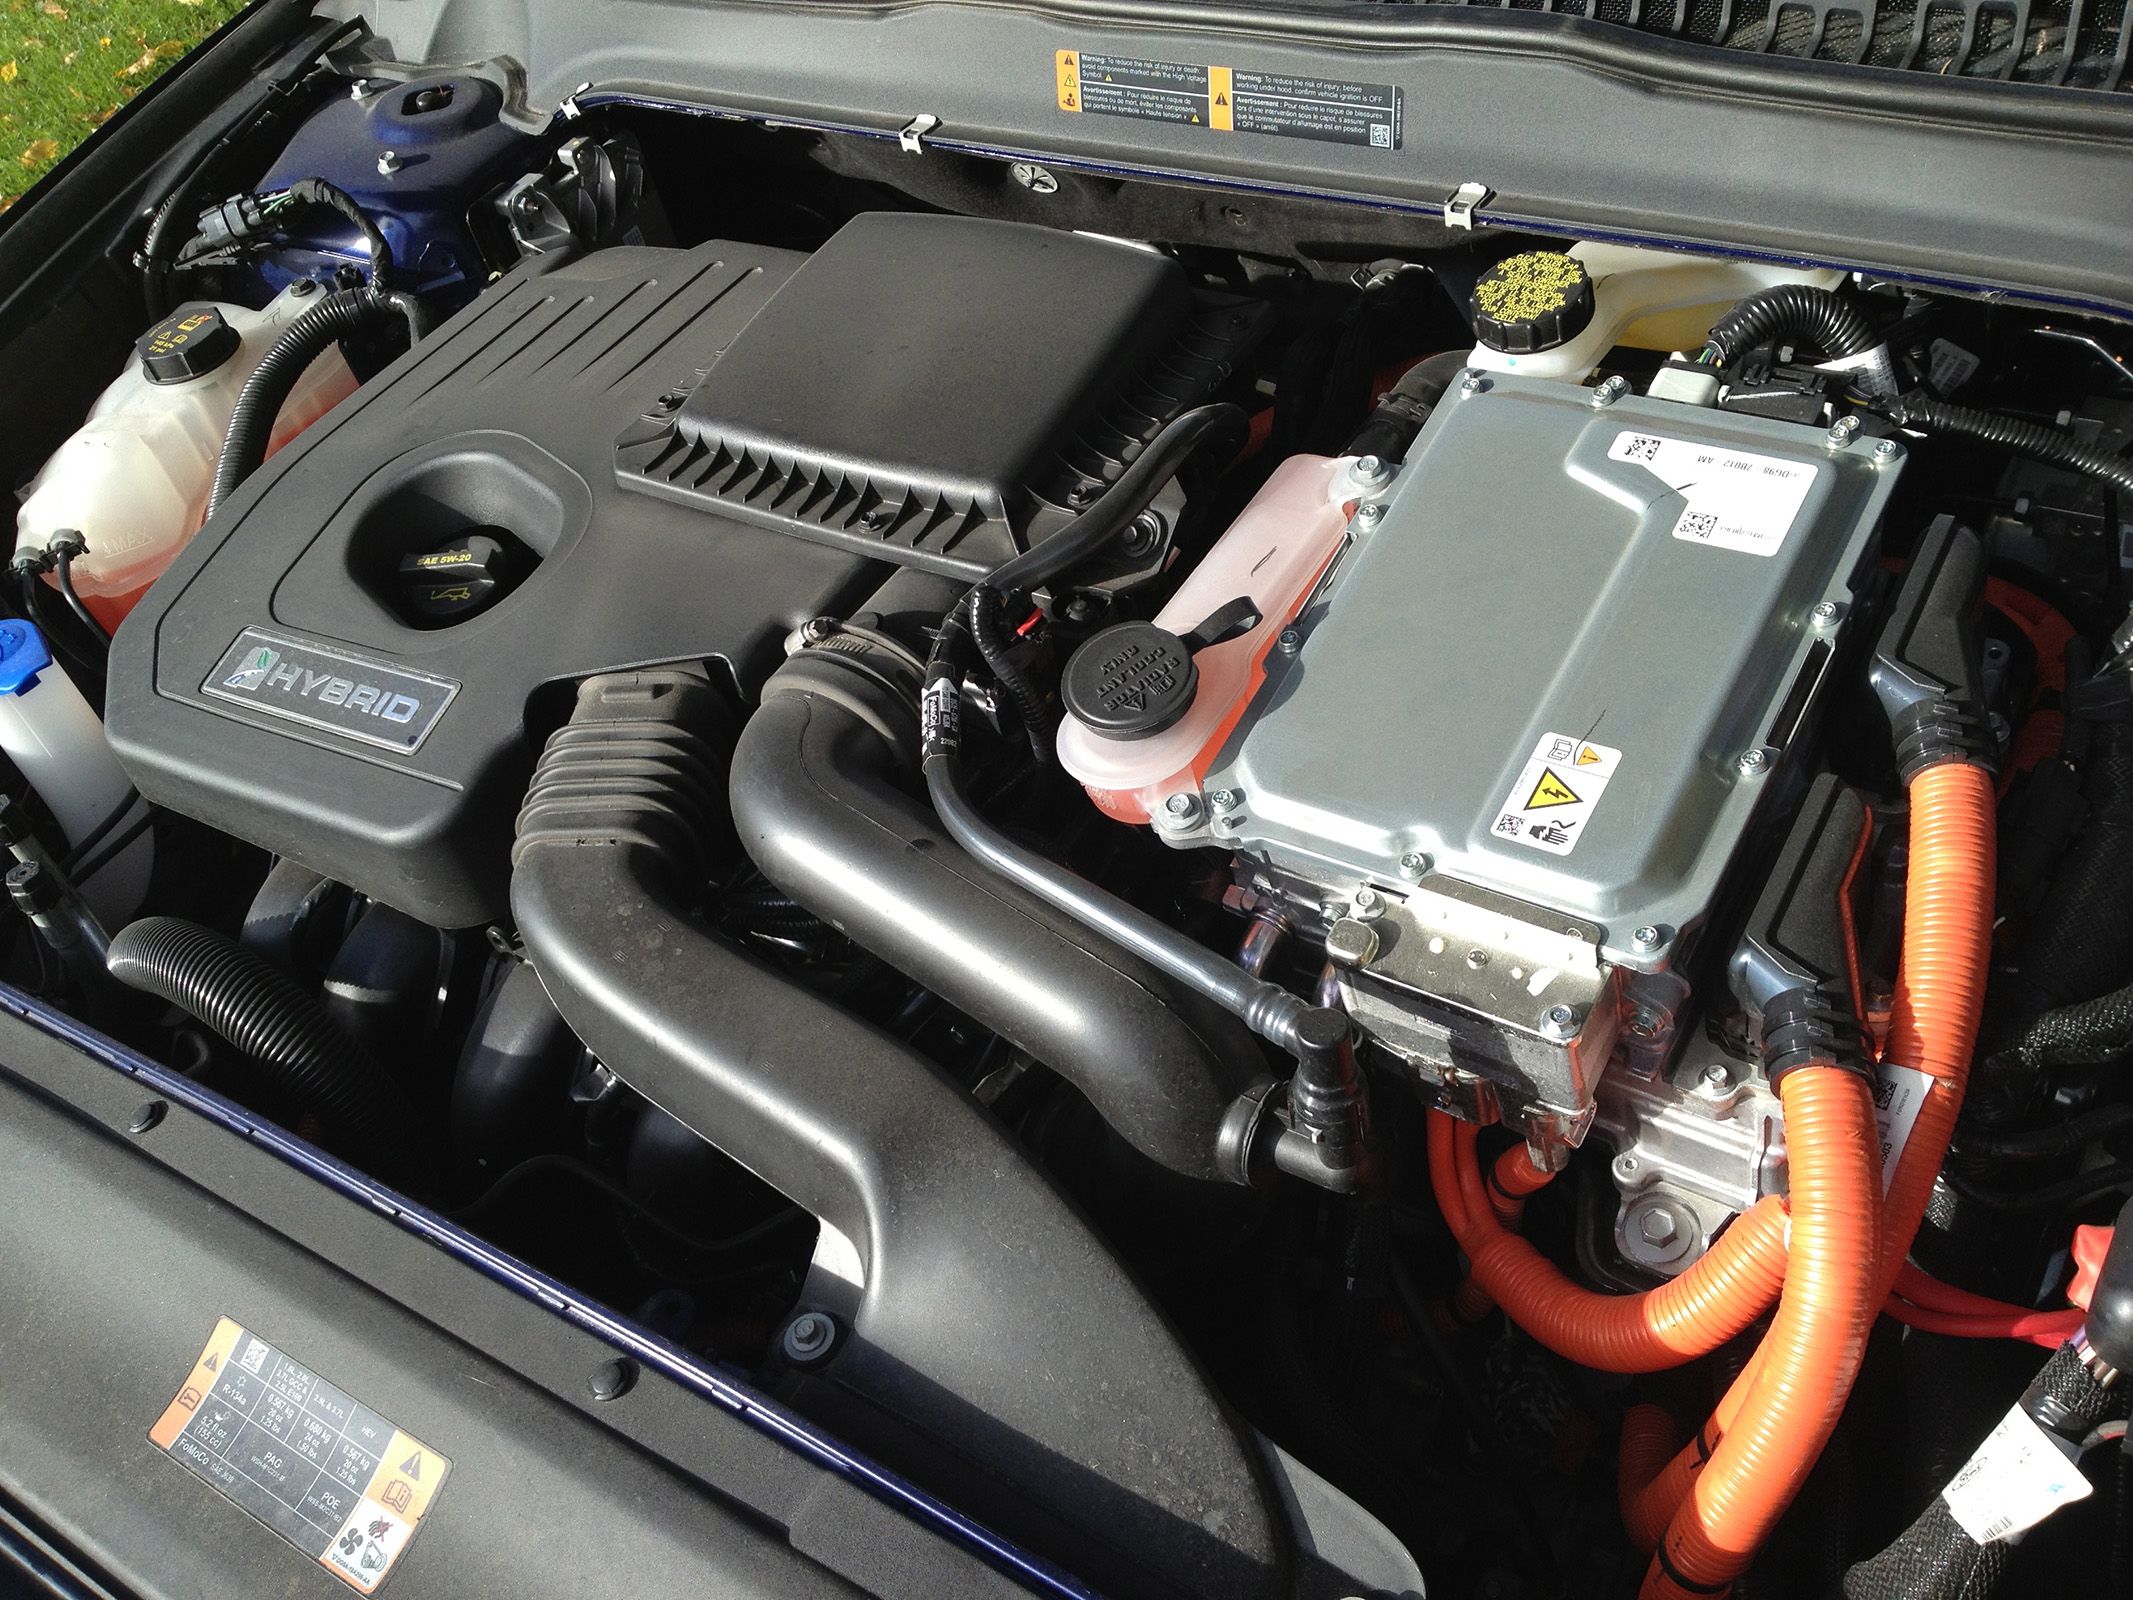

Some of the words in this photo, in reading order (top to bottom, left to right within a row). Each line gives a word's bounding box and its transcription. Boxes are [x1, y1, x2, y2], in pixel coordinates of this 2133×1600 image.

[1097, 64, 1128, 74] components
[1172, 72, 1185, 80] High
[1185, 74, 1206, 83] Voltage
[1161, 64, 1174, 72] injury
[1236, 80, 1258, 91] working
[1294, 87, 1316, 96] confirm
[1317, 89, 1338, 98] vehicle
[1339, 92, 1360, 102] ignition
[1272, 77, 1292, 85] reduce
[1342, 84, 1362, 92] before
[1083, 94, 1107, 102] blessures
[1164, 103, 1196, 113] composants
[1166, 95, 1182, 104] risque
[1092, 102, 1111, 111] portent
[1118, 105, 1139, 114] symbole
[1162, 110, 1182, 118] tension
[1264, 107, 1296, 117] intervention
[1326, 106, 1344, 115] risque
[1354, 110, 1382, 119] blessures
[1254, 114, 1290, 124] commutateur
[1343, 125, 1365, 134] position
[1698, 455, 1714, 464] AM
[111, 526, 152, 552] MAX
[417, 555, 439, 566] SAE
[440, 552, 472, 564] 5W-20
[1100, 645, 1140, 676] ONLY
[1096, 646, 1166, 698] COOLANT
[267, 662, 421, 723] HYBRID
[1104, 657, 1180, 711] RADIATOR
[221, 1382, 248, 1405] R-134a
[266, 1392, 286, 1411] 0.567
[282, 1404, 296, 1420] kg
[267, 1407, 277, 1418] 20
[274, 1413, 284, 1423] oz
[192, 1423, 212, 1442] (155
[207, 1433, 223, 1450] cc)
[200, 1414, 214, 1428] 5.2
[211, 1422, 219, 1432] fl
[216, 1427, 227, 1439] oz
[270, 1421, 282, 1434] lbs
[302, 1417, 324, 1436] 0.680
[318, 1428, 333, 1444] kg
[360, 1425, 376, 1439] HEV
[295, 1439, 309, 1453] 1.50
[306, 1446, 319, 1459] lbs
[303, 1431, 313, 1442] 24
[310, 1438, 320, 1448] oz
[177, 1437, 211, 1466] FoMoCo
[263, 1450, 283, 1469] PAG
[341, 1443, 362, 1462] 0.567
[357, 1455, 372, 1471] kg
[334, 1465, 349, 1479] 1.25
[345, 1473, 358, 1486] lbs
[342, 1458, 352, 1469] 20
[349, 1464, 359, 1474] oz
[319, 1490, 342, 1510] POE
